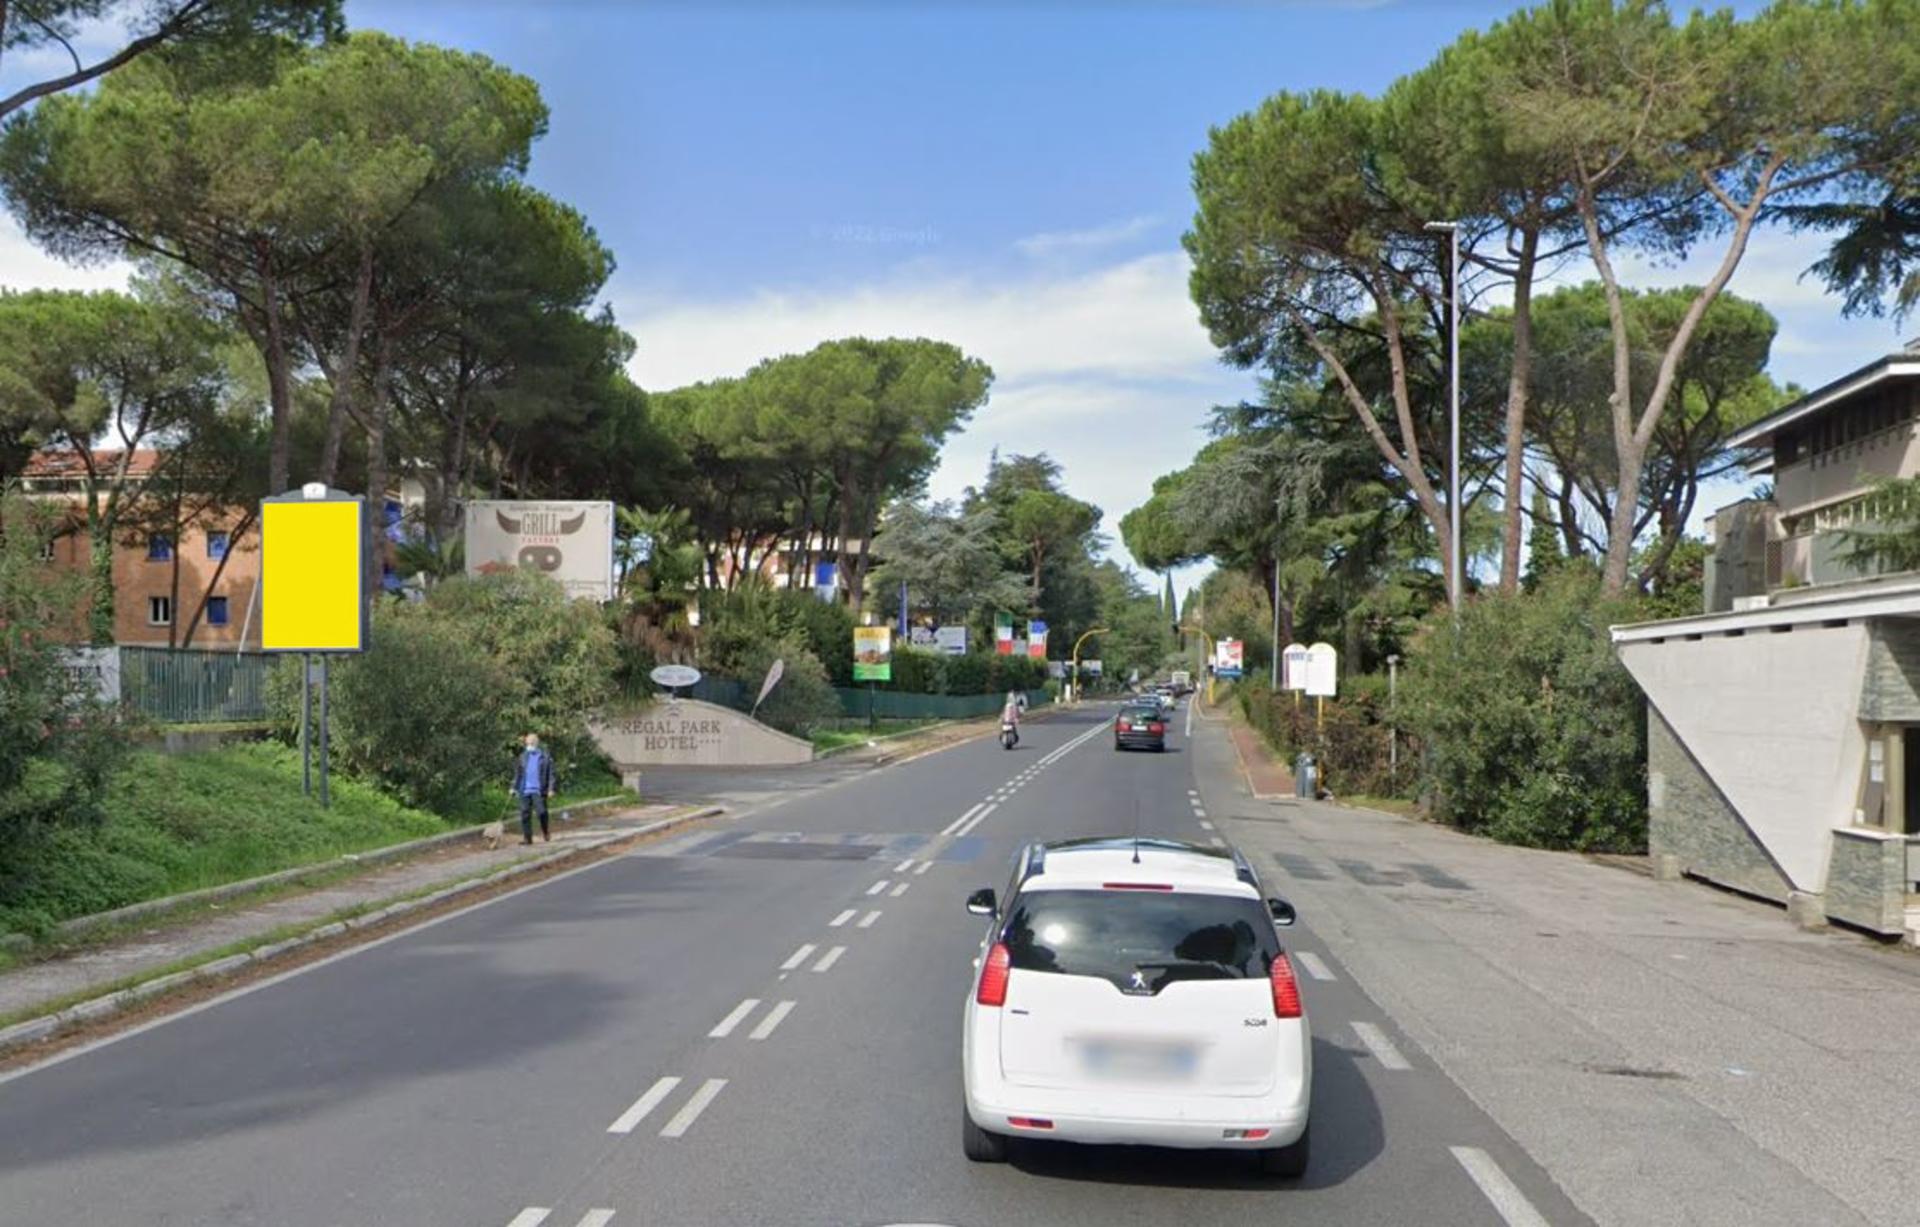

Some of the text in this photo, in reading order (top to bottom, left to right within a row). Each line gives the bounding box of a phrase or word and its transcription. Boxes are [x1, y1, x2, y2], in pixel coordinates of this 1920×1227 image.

[521, 512, 560, 535] GRILL
[621, 720, 721, 735] REGAL PARK
[644, 736, 698, 750] HOTEL
